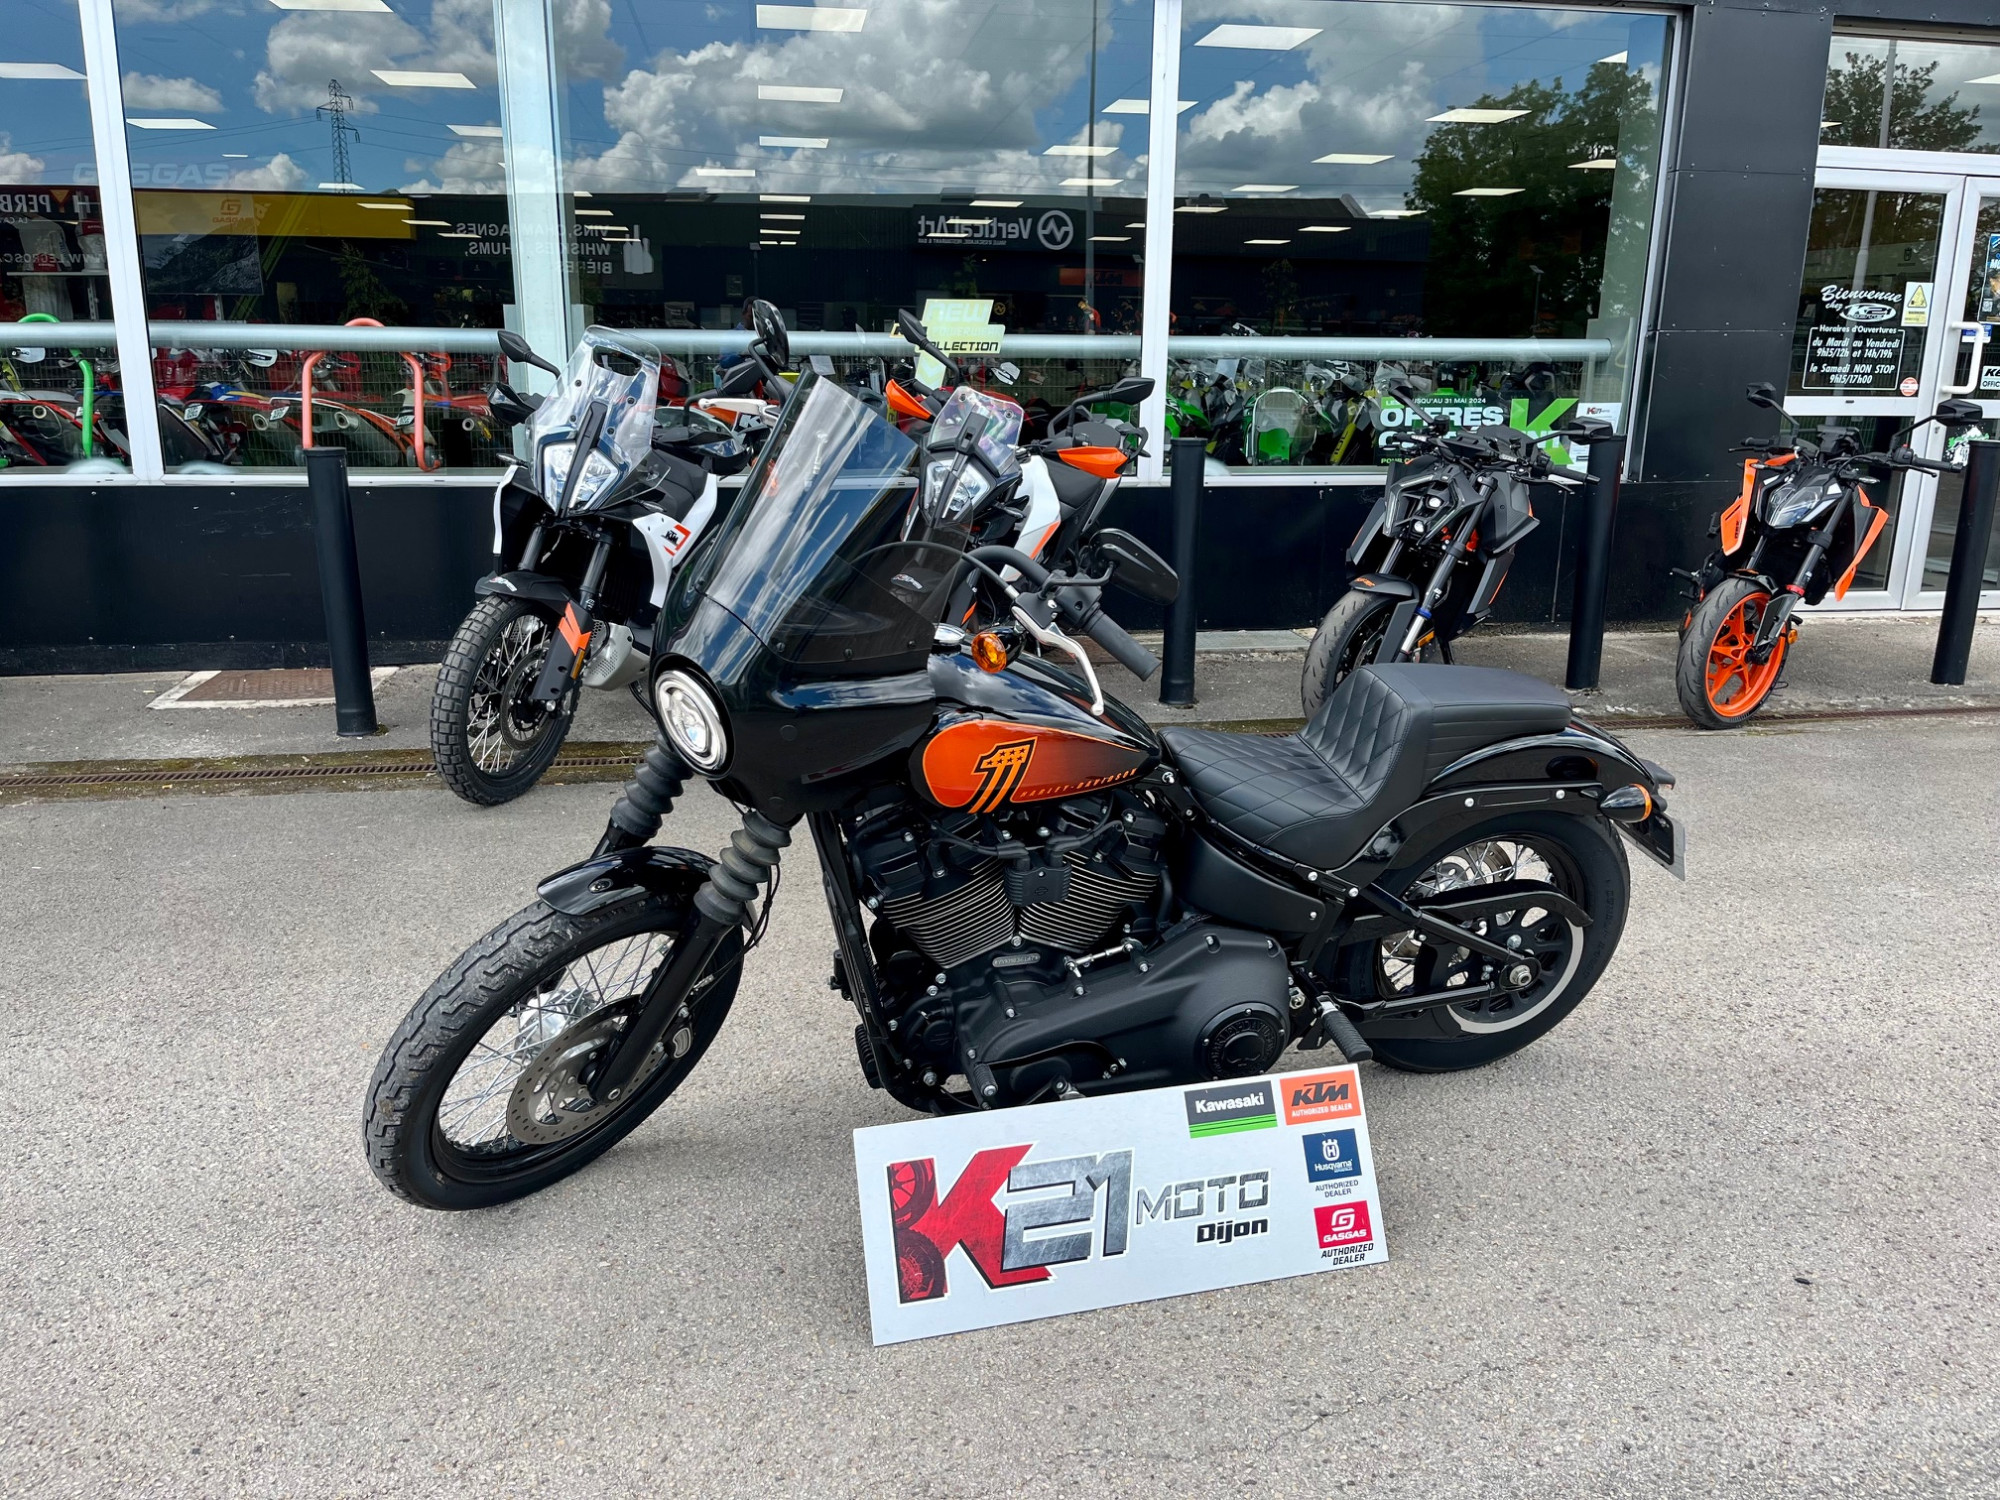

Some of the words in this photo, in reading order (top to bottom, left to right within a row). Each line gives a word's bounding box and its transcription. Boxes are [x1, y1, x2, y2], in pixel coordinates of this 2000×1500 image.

[73, 163, 229, 185] GSGAS
[1821, 285, 1902, 302] Bienvenue
[1825, 300, 1843, 311] chez
[1852, 325, 1896, 333] d'Ouvertures
[919, 342, 999, 351] OLLECTION
[1812, 337, 1822, 346] du
[1826, 337, 1850, 347] Mardi
[1866, 338, 1900, 348] Vendredi
[1816, 348, 1849, 358] 9h15/12h
[1864, 349, 1892, 359] 14h/19h
[1809, 363, 1818, 372] le
[1821, 363, 1850, 373] Samedi
[1853, 364, 1872, 373] NON
[1875, 364, 1895, 374] STOP
[1830, 374, 1872, 384] 9h15/17h00
[1380, 406, 1504, 427] OFFRES
[1291, 1080, 1349, 1106] KTM
[1195, 1092, 1264, 1113] Kawasaki
[1291, 1106, 1328, 1117] AUTHORIZED
[1330, 1102, 1352, 1113] DEALER
[1314, 1160, 1353, 1172] Husqvarna
[1315, 1180, 1358, 1191] AUTHORIZED
[1136, 1171, 1269, 1225] MOTO
[1324, 1188, 1352, 1198] DEALER
[1196, 1219, 1268, 1244] Dijon
[1323, 1229, 1366, 1243] GASGAS
[1321, 1242, 1374, 1258] AUTHORIZED
[1332, 1253, 1365, 1266] DEALER
